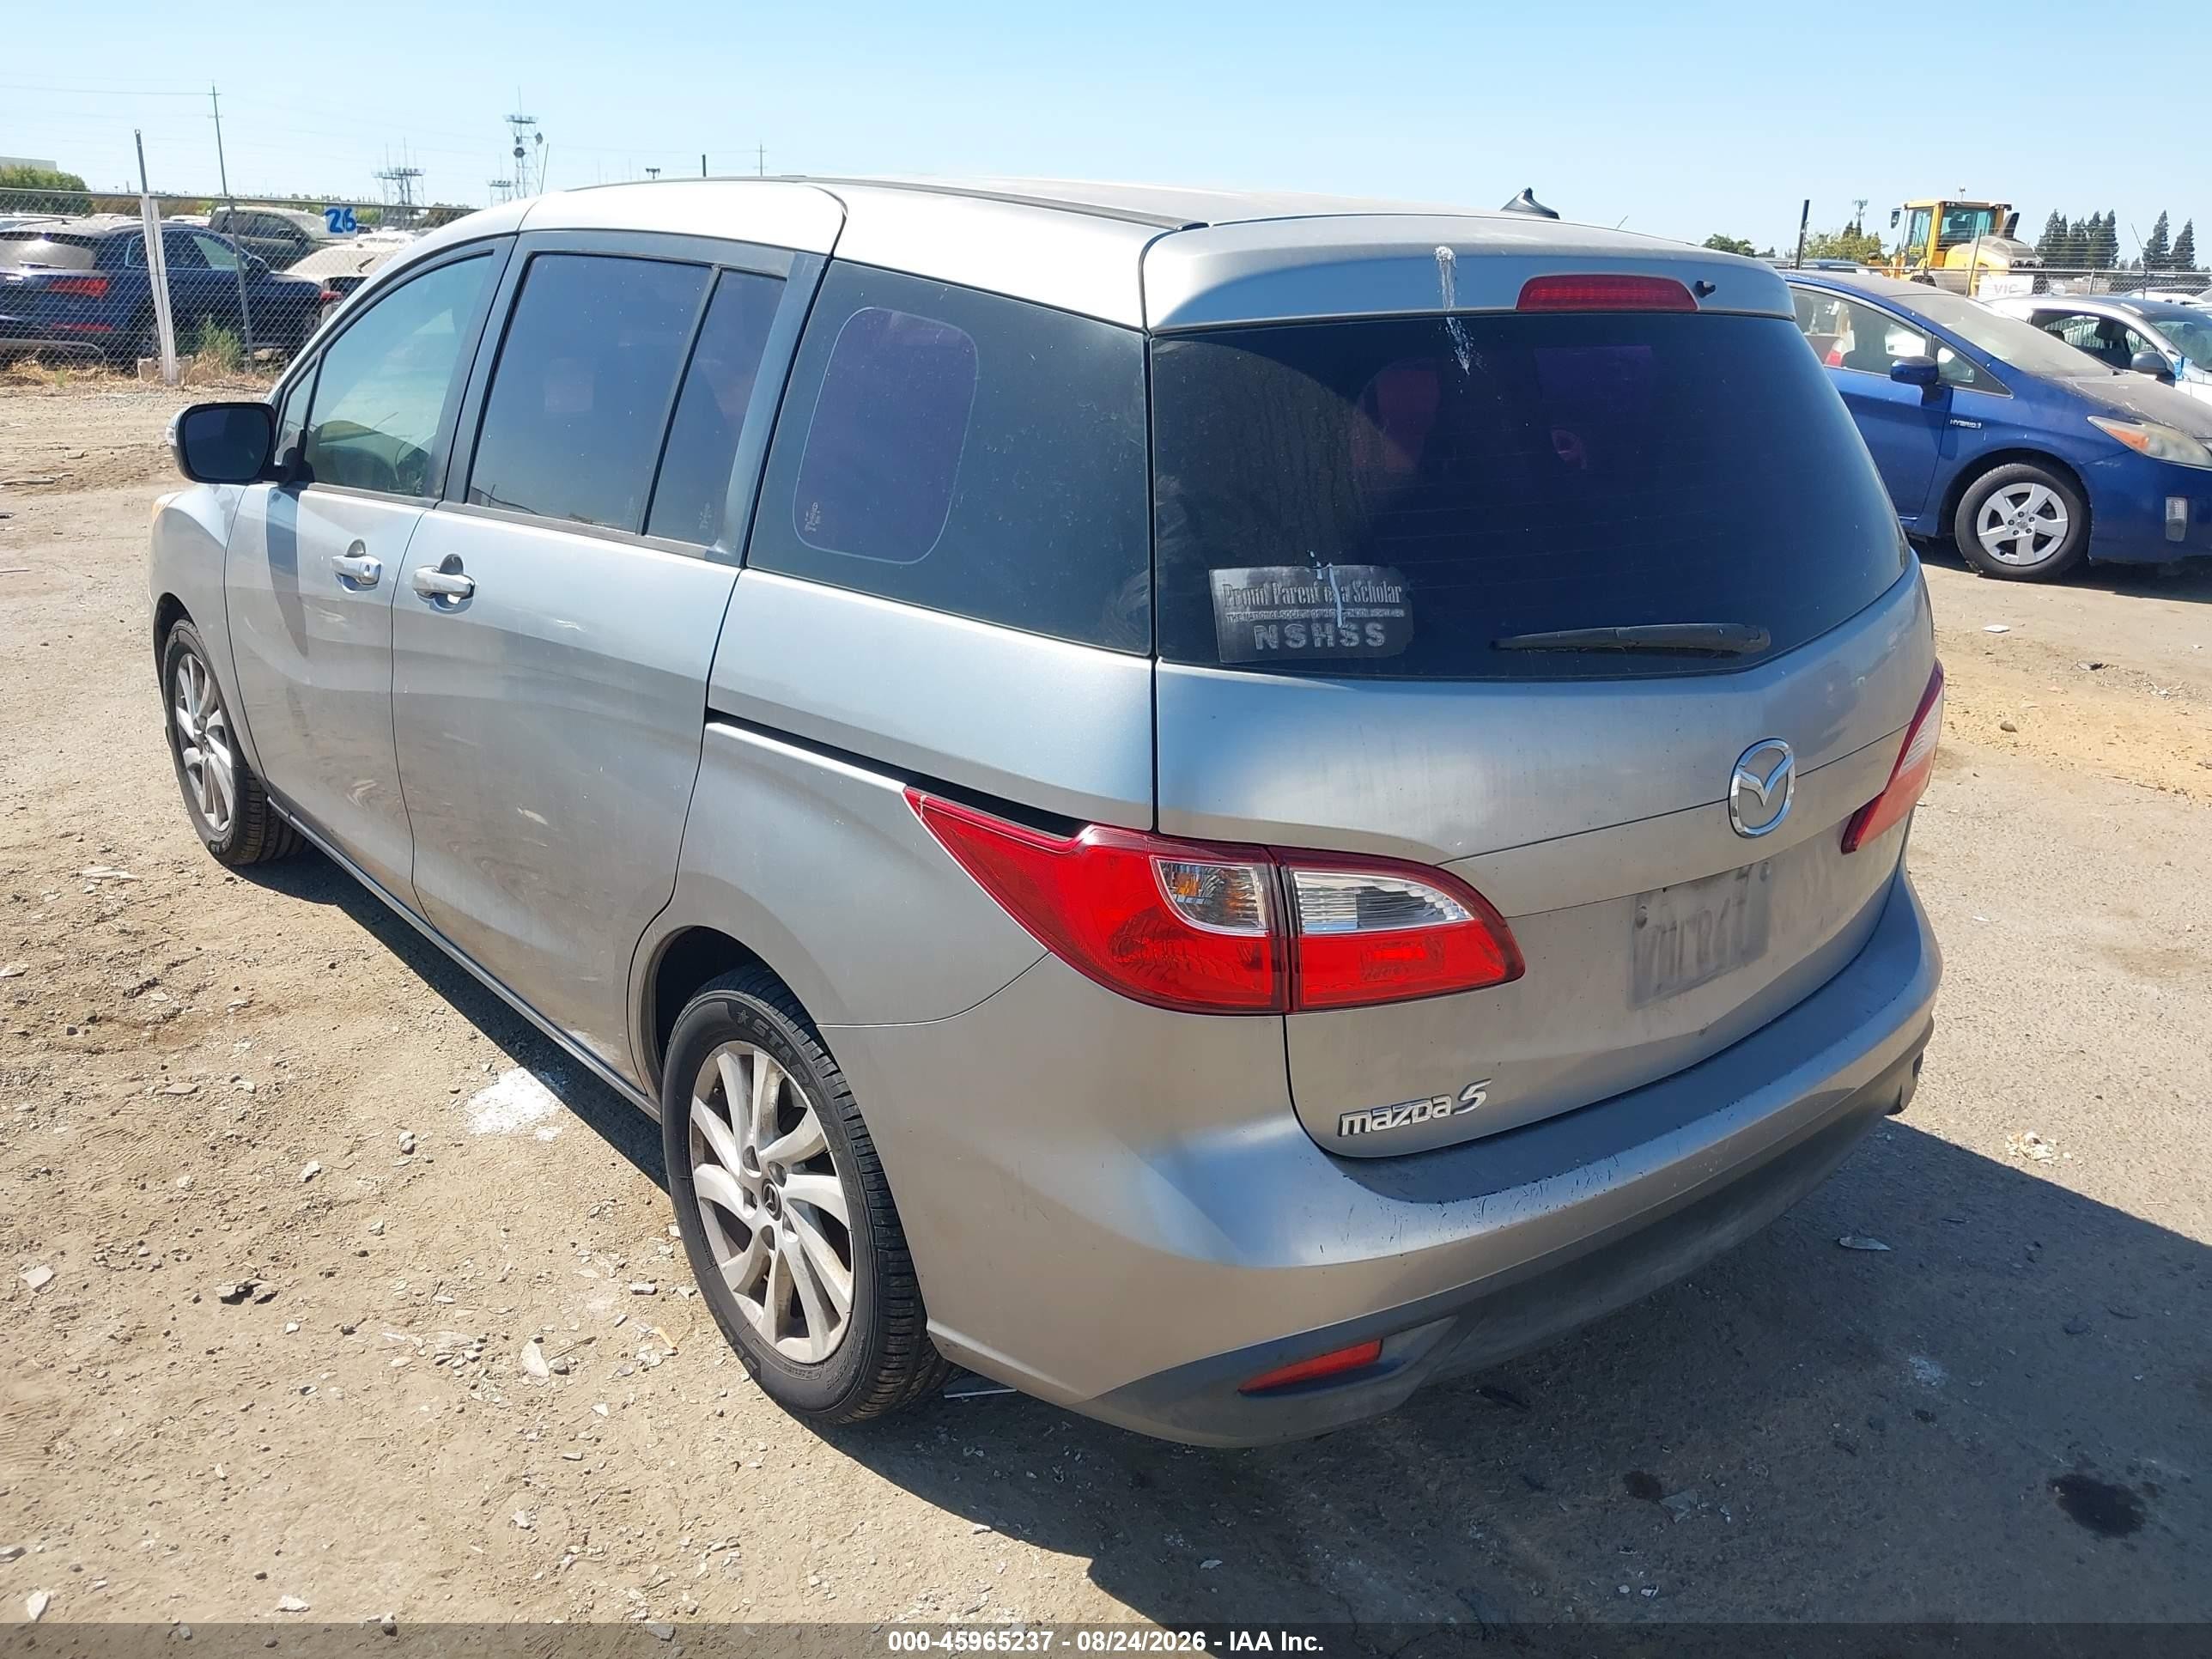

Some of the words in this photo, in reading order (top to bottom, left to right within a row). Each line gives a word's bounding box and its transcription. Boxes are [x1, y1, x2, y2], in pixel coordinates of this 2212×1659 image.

[325, 207, 357, 234] 26
[1222, 583, 1268, 607] Proud
[1272, 580, 1319, 605] Parent
[1352, 580, 1402, 604] Scholar
[1254, 623, 1385, 650] NSHSS
